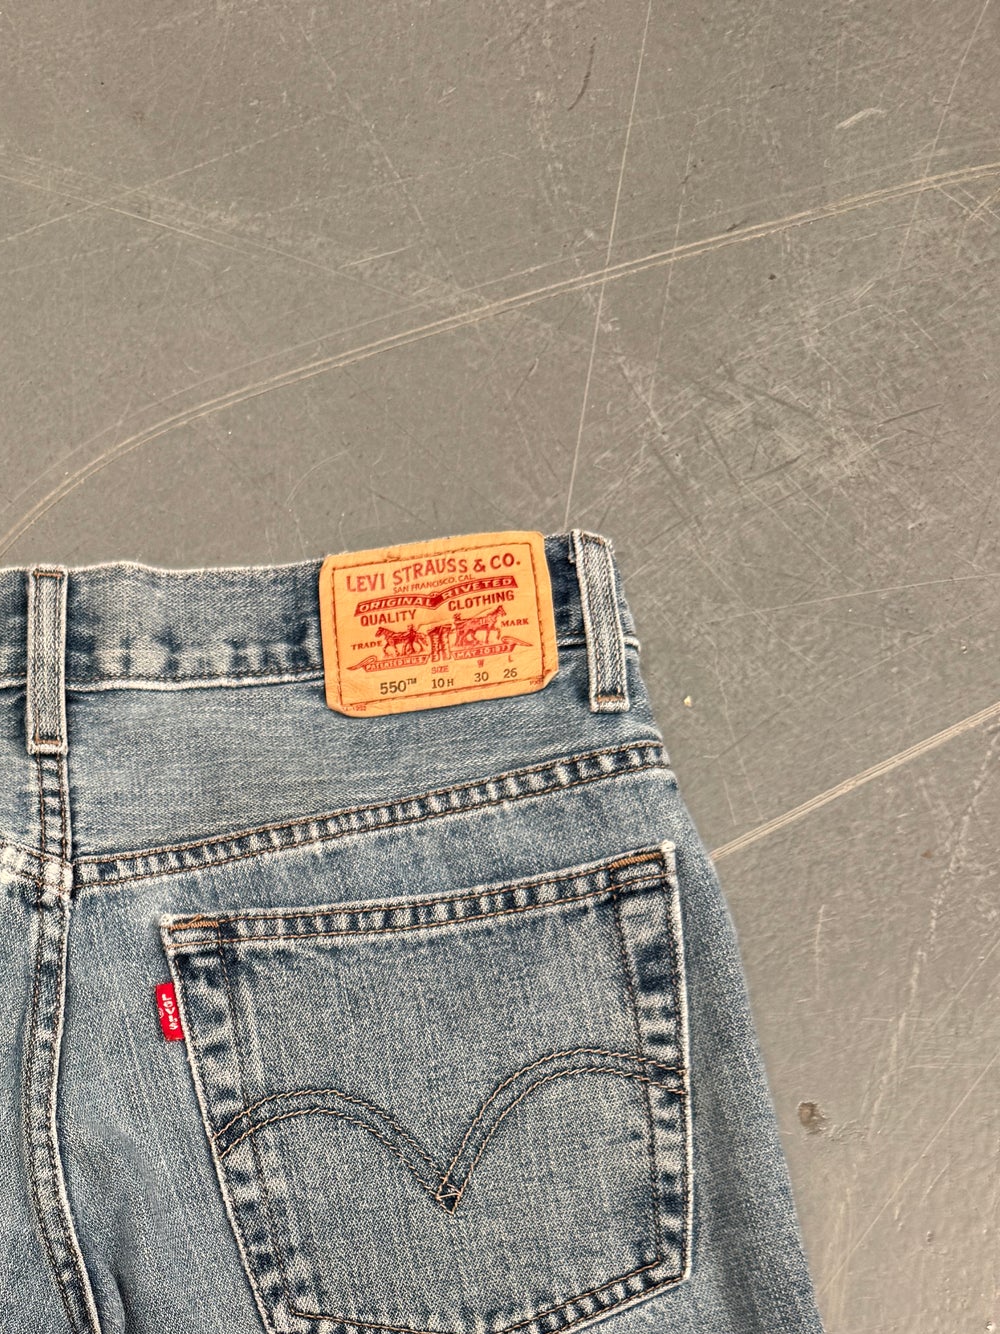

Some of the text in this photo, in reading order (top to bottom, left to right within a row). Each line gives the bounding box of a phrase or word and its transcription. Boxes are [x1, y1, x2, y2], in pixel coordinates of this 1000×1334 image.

[346, 552, 521, 592] LEVI STRAUSS & CO.
[360, 578, 513, 613] ORIGINAL RIVETED
[393, 585, 409, 595] SAN
[360, 590, 514, 627] QUALITY CLOTHING
[351, 618, 529, 651] TRADE MARK
[431, 665, 449, 675] SIZE
[508, 655, 514, 663] L
[474, 671, 489, 683] 30
[503, 667, 518, 679] 26
